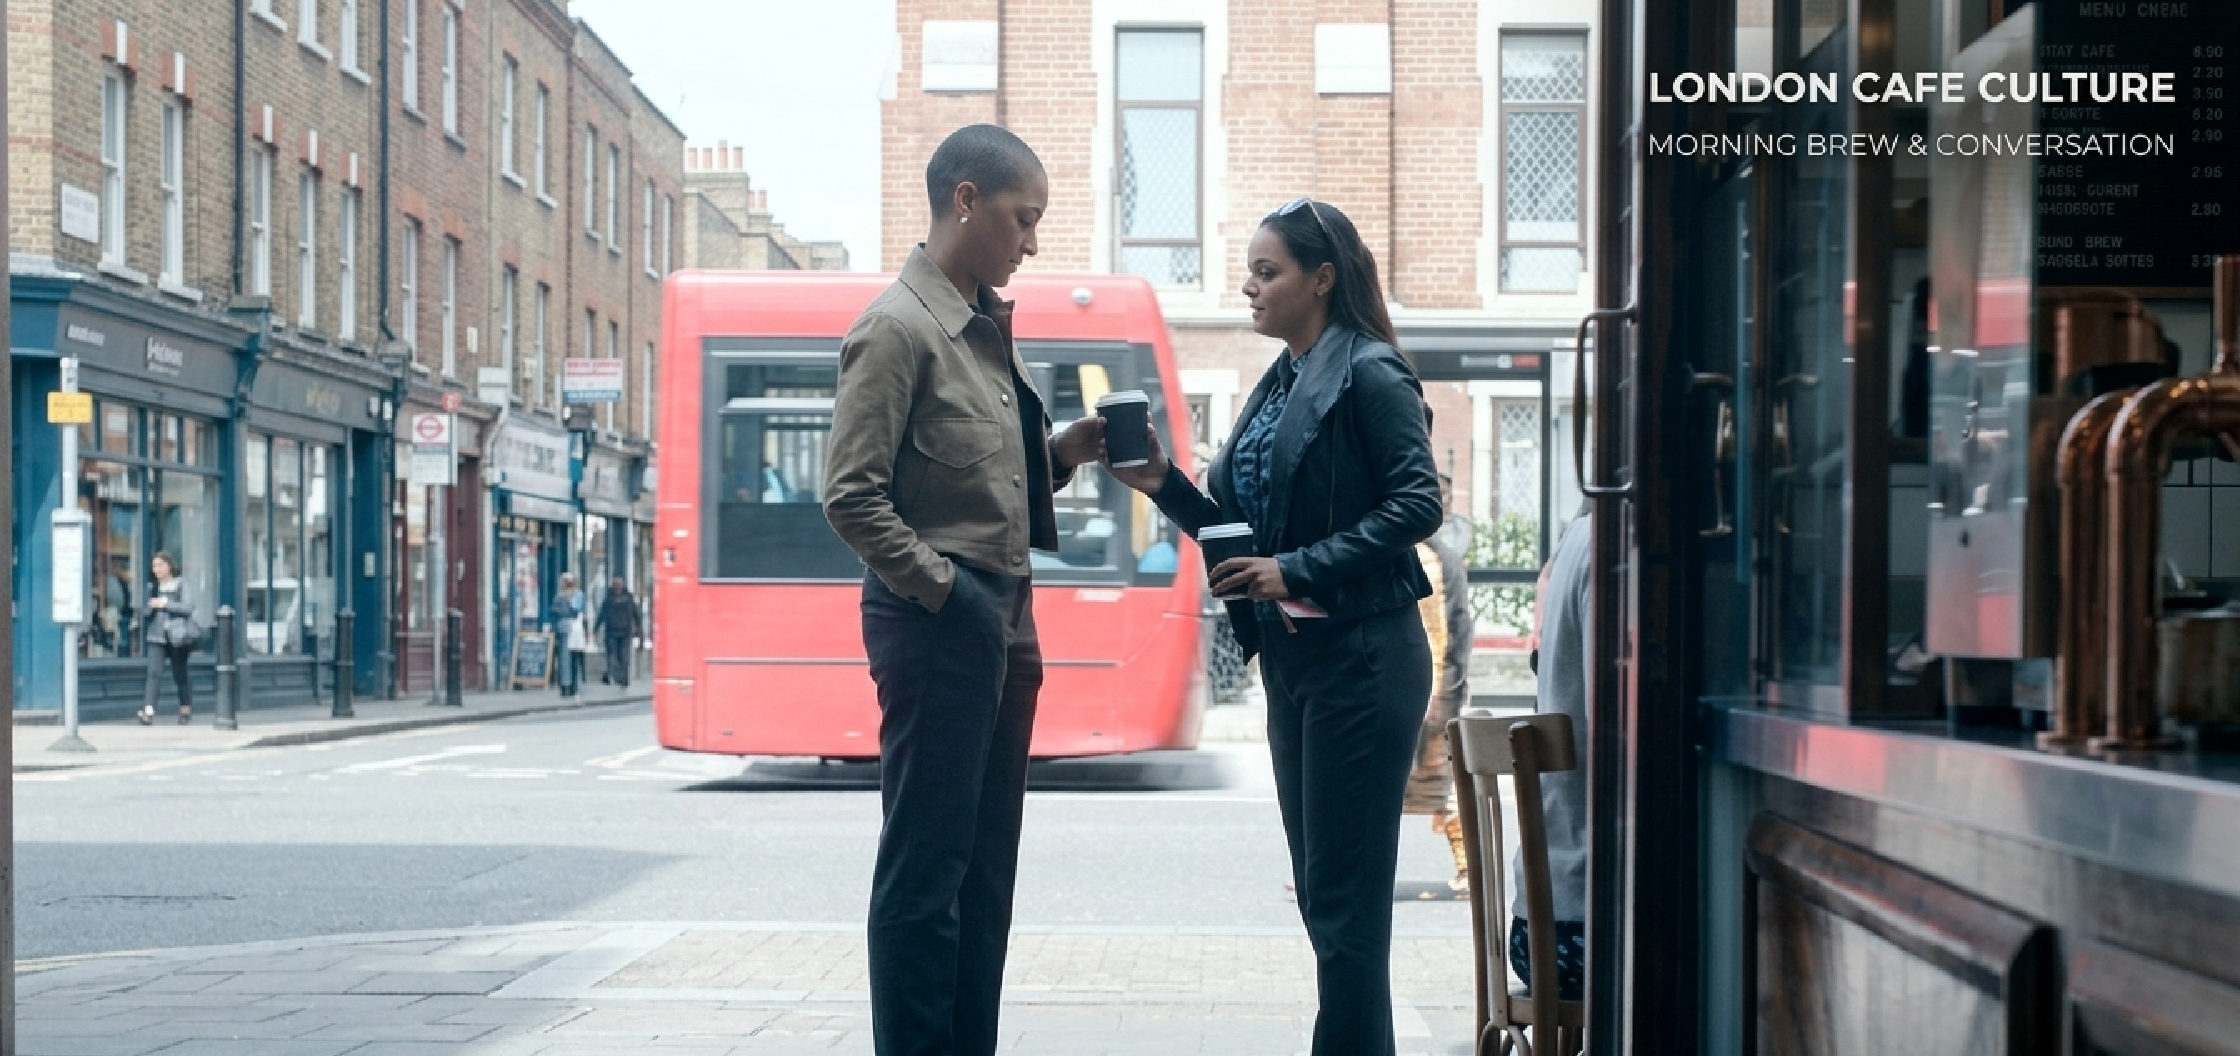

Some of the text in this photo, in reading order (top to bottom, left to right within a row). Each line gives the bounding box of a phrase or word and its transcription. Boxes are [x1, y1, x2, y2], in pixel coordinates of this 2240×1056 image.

[2079, 2, 2126, 17] MENU
[2081, 44, 2115, 58] CAFE
[2192, 66, 2223, 78] 2.20
[2085, 236, 2123, 248] BREW
